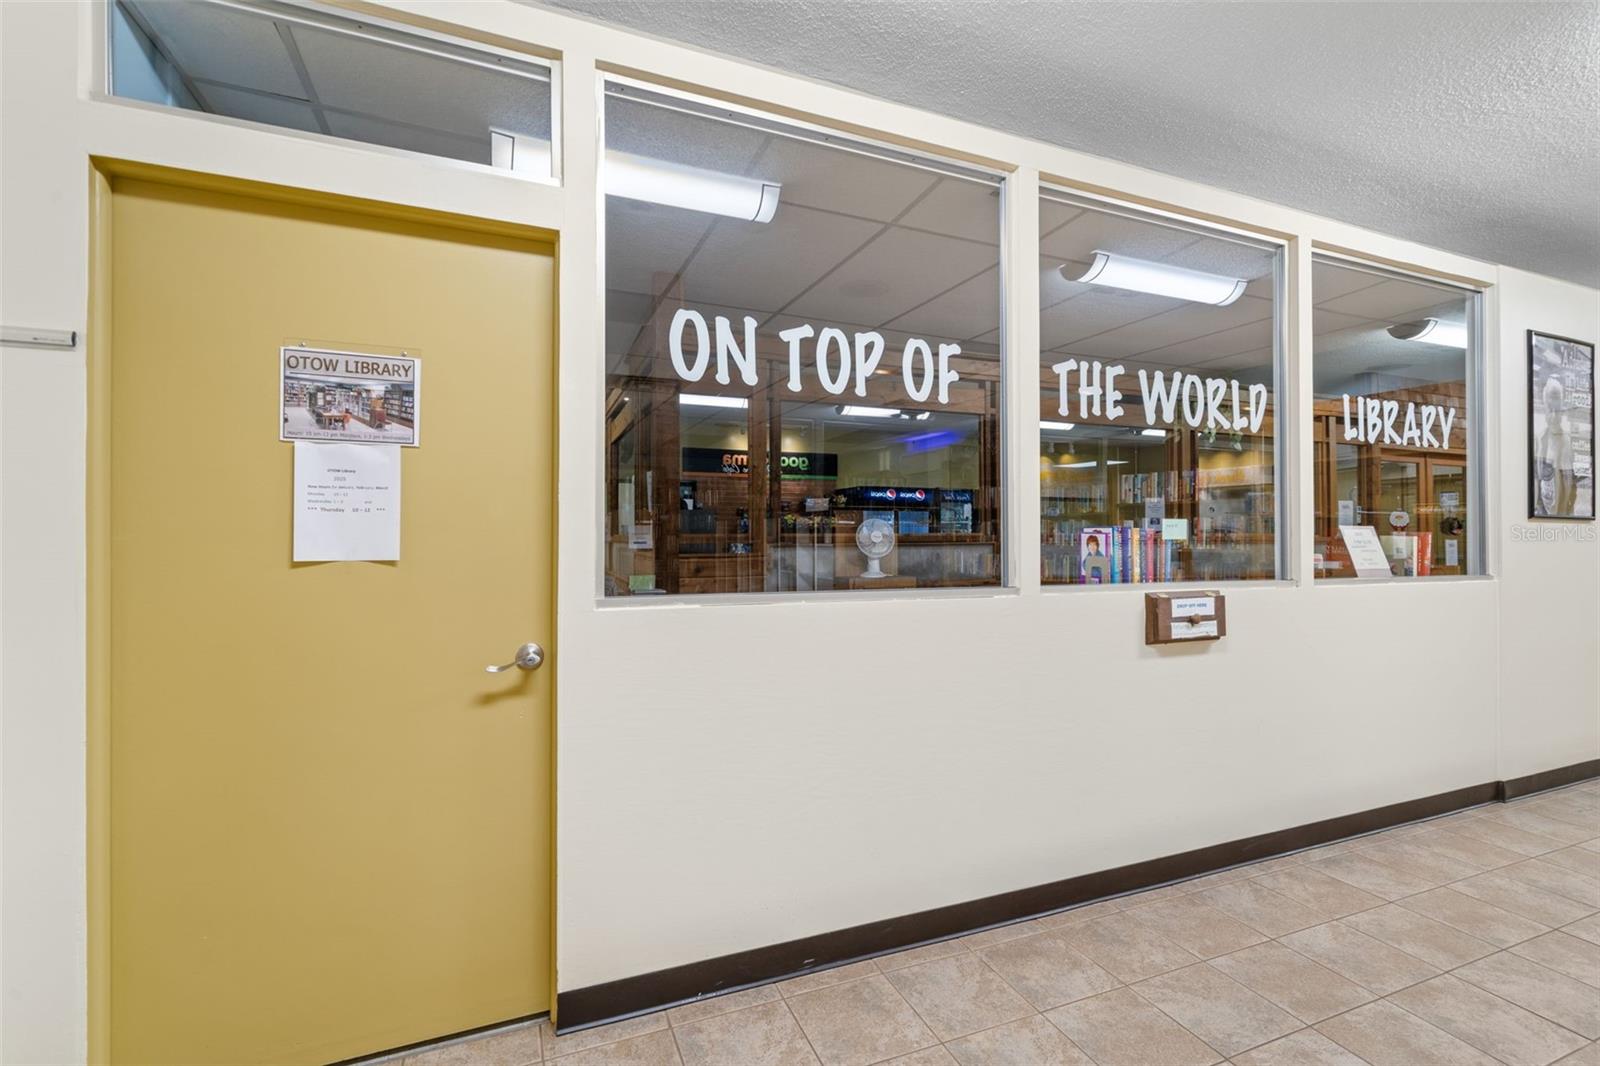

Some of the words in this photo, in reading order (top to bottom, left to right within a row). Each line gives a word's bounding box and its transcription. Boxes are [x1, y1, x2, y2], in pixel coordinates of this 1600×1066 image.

[286, 355, 339, 372] OTOW
[345, 359, 412, 378] LIBRARY
[668, 308, 758, 386] ON
[779, 324, 885, 397] TOP
[902, 338, 962, 404] OF
[1052, 358, 1126, 421] THE
[1138, 369, 1268, 434] WORLD
[1342, 393, 1456, 450] LIBRARY
